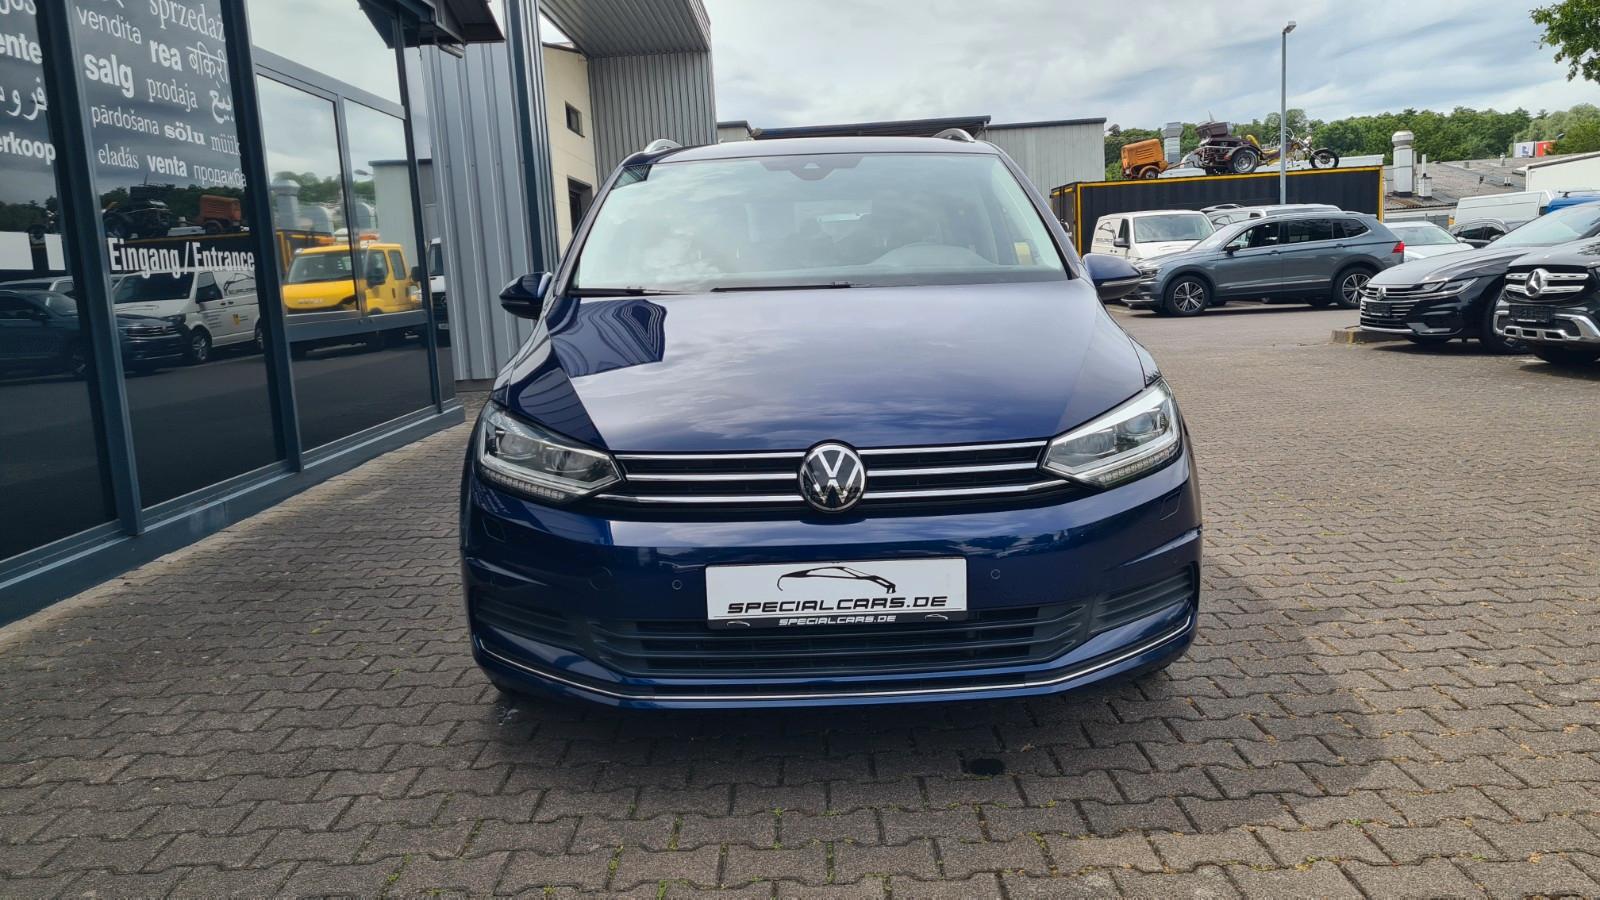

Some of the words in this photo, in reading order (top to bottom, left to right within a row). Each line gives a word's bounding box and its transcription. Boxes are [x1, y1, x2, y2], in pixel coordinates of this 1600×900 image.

[76, 6, 142, 45] vendita
[149, 39, 182, 72] rea
[84, 53, 135, 98] salg
[146, 78, 198, 112] prodaja
[91, 105, 160, 135] pārdošana
[164, 122, 206, 145] sölu
[98, 144, 140, 169] eladás
[147, 154, 188, 177] venta
[727, 595, 948, 614] SPECIALCARS.DE
[778, 614, 897, 626] SPECIALCARS.DE
